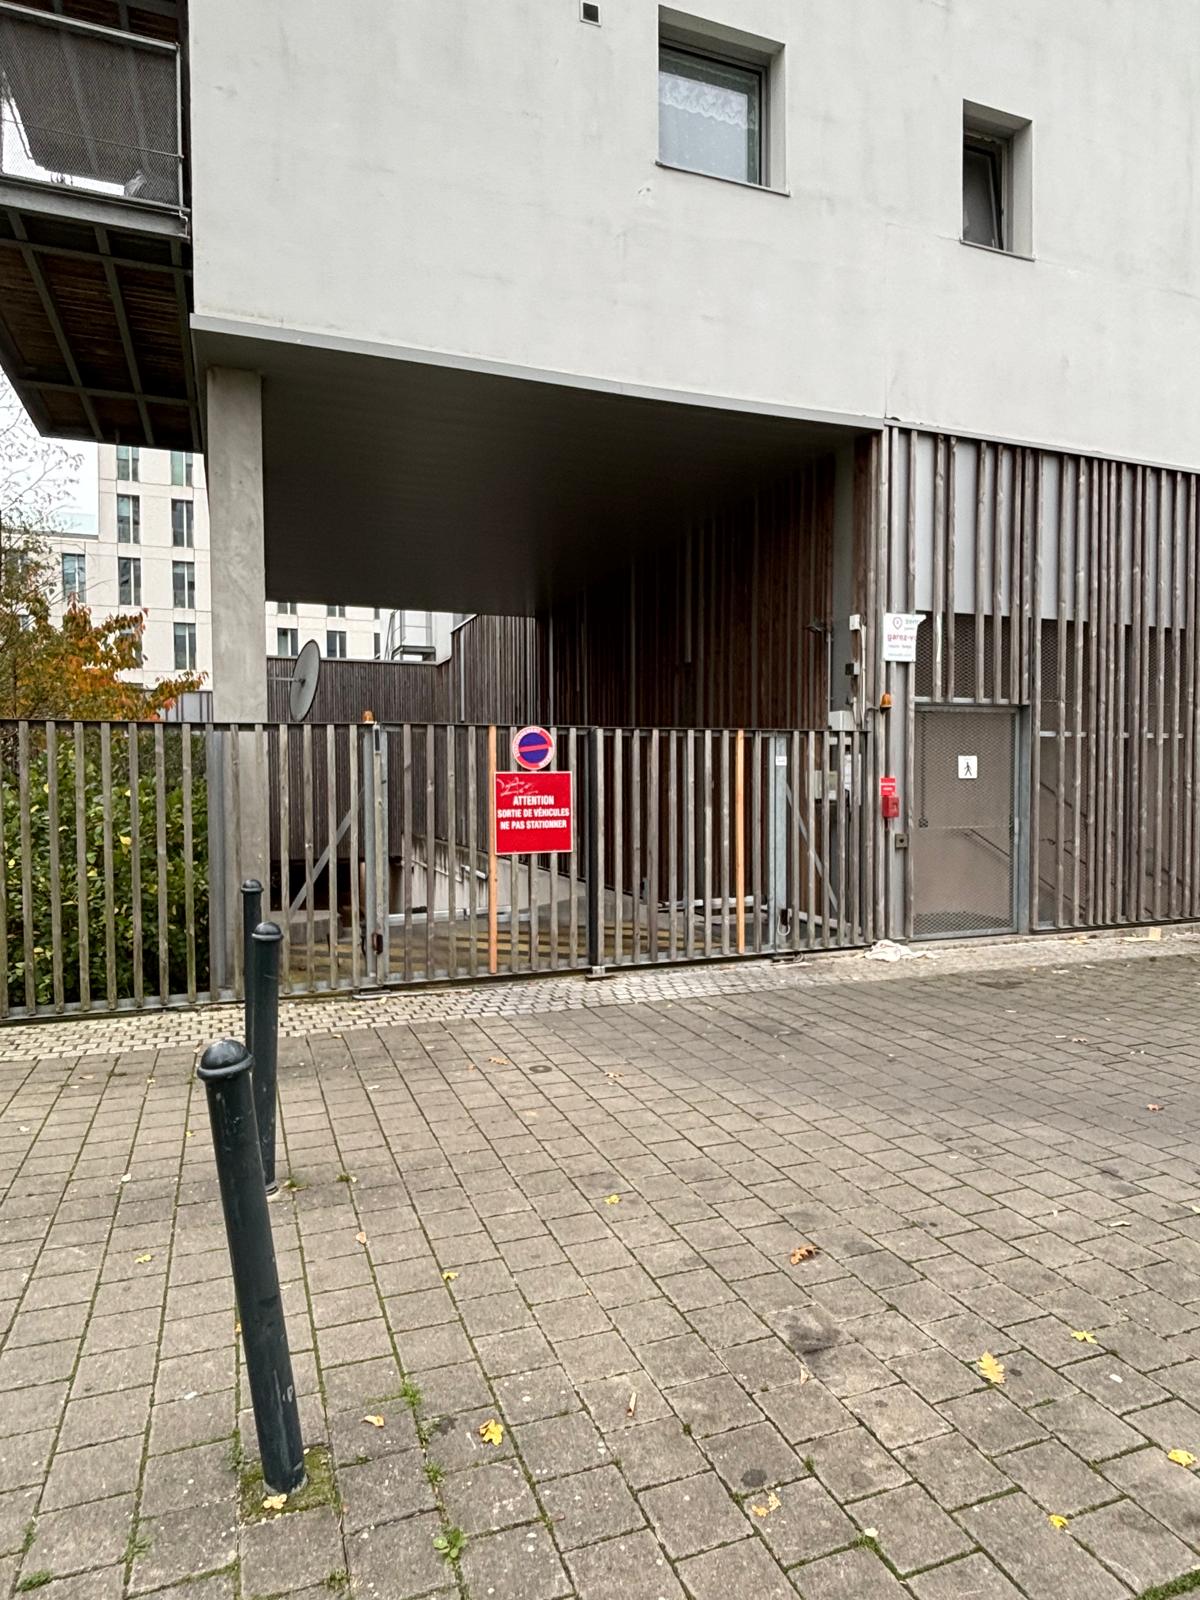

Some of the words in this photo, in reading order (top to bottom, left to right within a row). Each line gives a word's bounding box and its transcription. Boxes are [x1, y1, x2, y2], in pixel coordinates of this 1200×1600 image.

[513, 795, 554, 806] ATTENTION
[497, 808, 522, 818] SORTIE
[523, 808, 533, 818] DE
[533, 807, 570, 817] VÉHICULES
[500, 821, 510, 830] NE
[511, 820, 525, 830] PAS
[526, 819, 567, 830] STATIONNER
